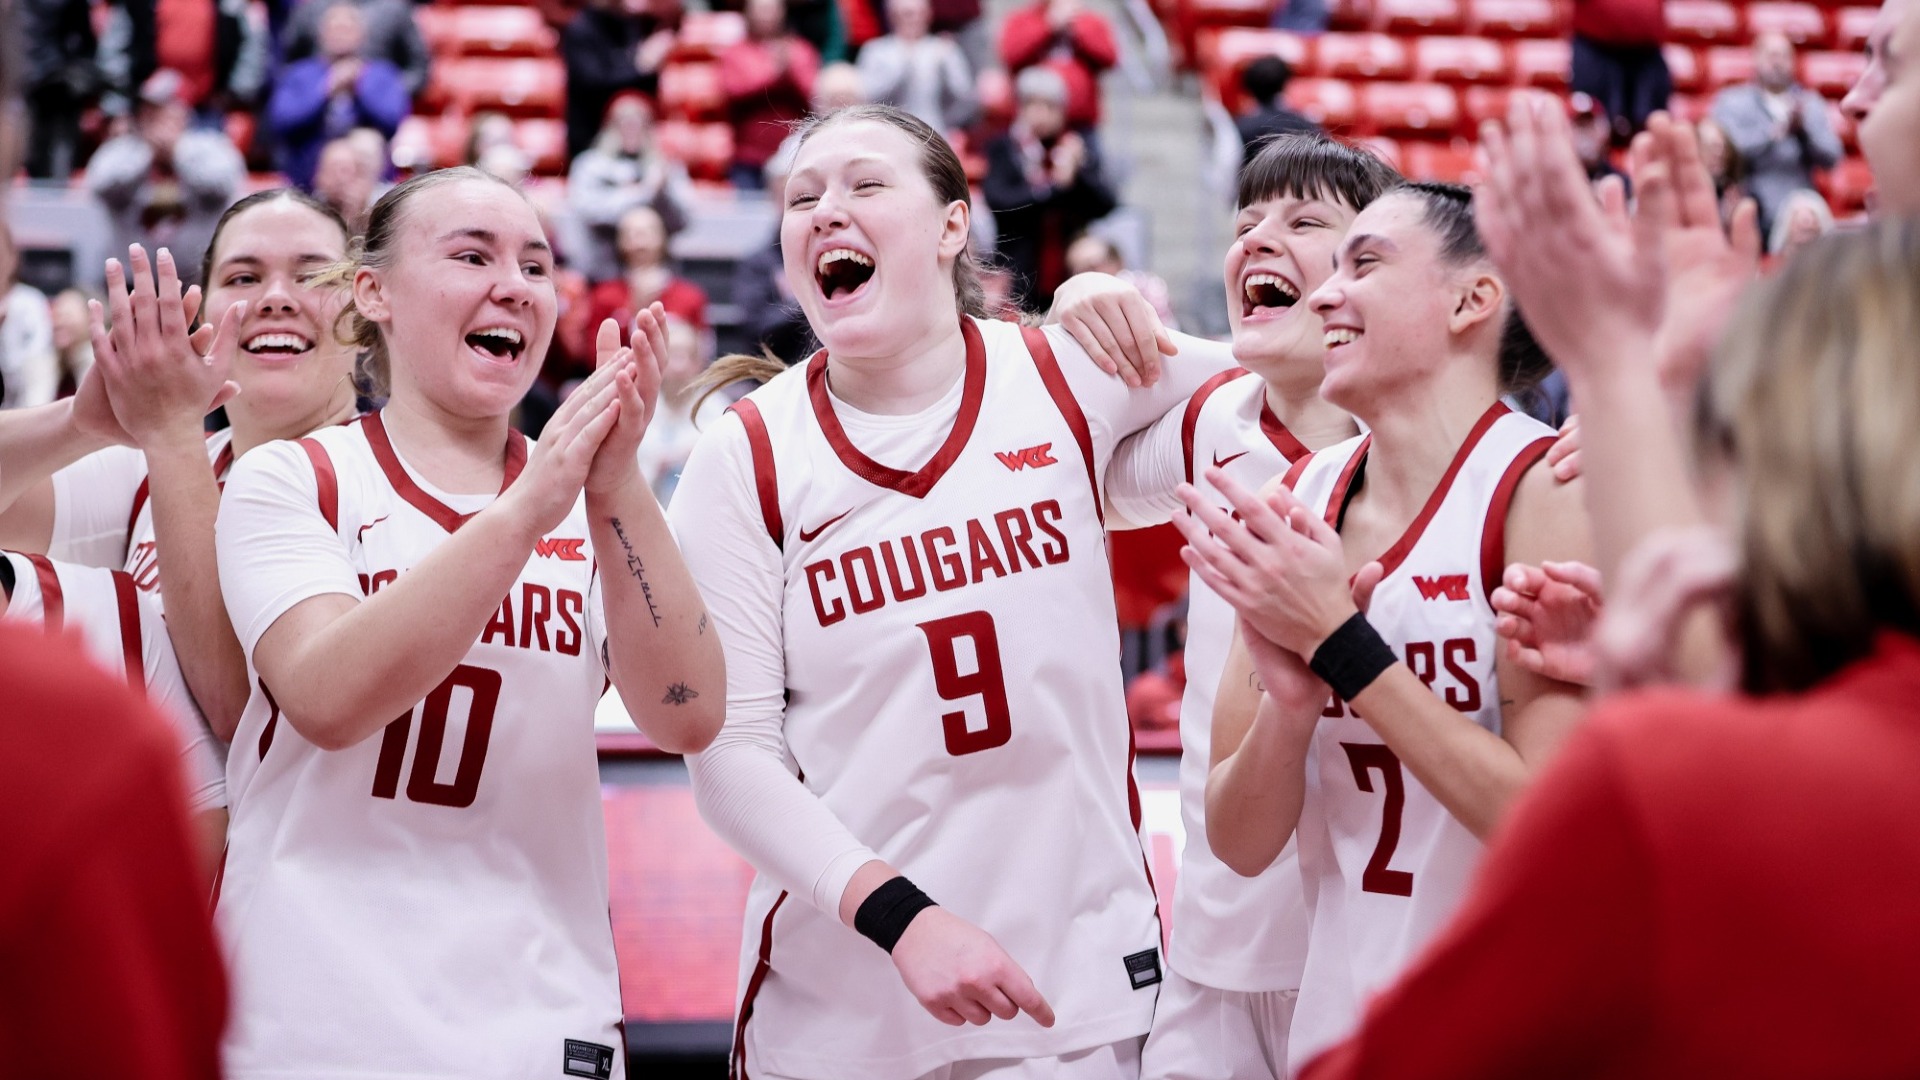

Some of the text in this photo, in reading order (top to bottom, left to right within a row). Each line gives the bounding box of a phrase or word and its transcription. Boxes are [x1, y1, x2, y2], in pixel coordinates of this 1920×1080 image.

[994, 442, 1058, 472] WCC
[803, 499, 1070, 628] COUGARS
[371, 664, 502, 808] 10
[915, 610, 1012, 756] 9
[1339, 742, 1413, 897] 2
